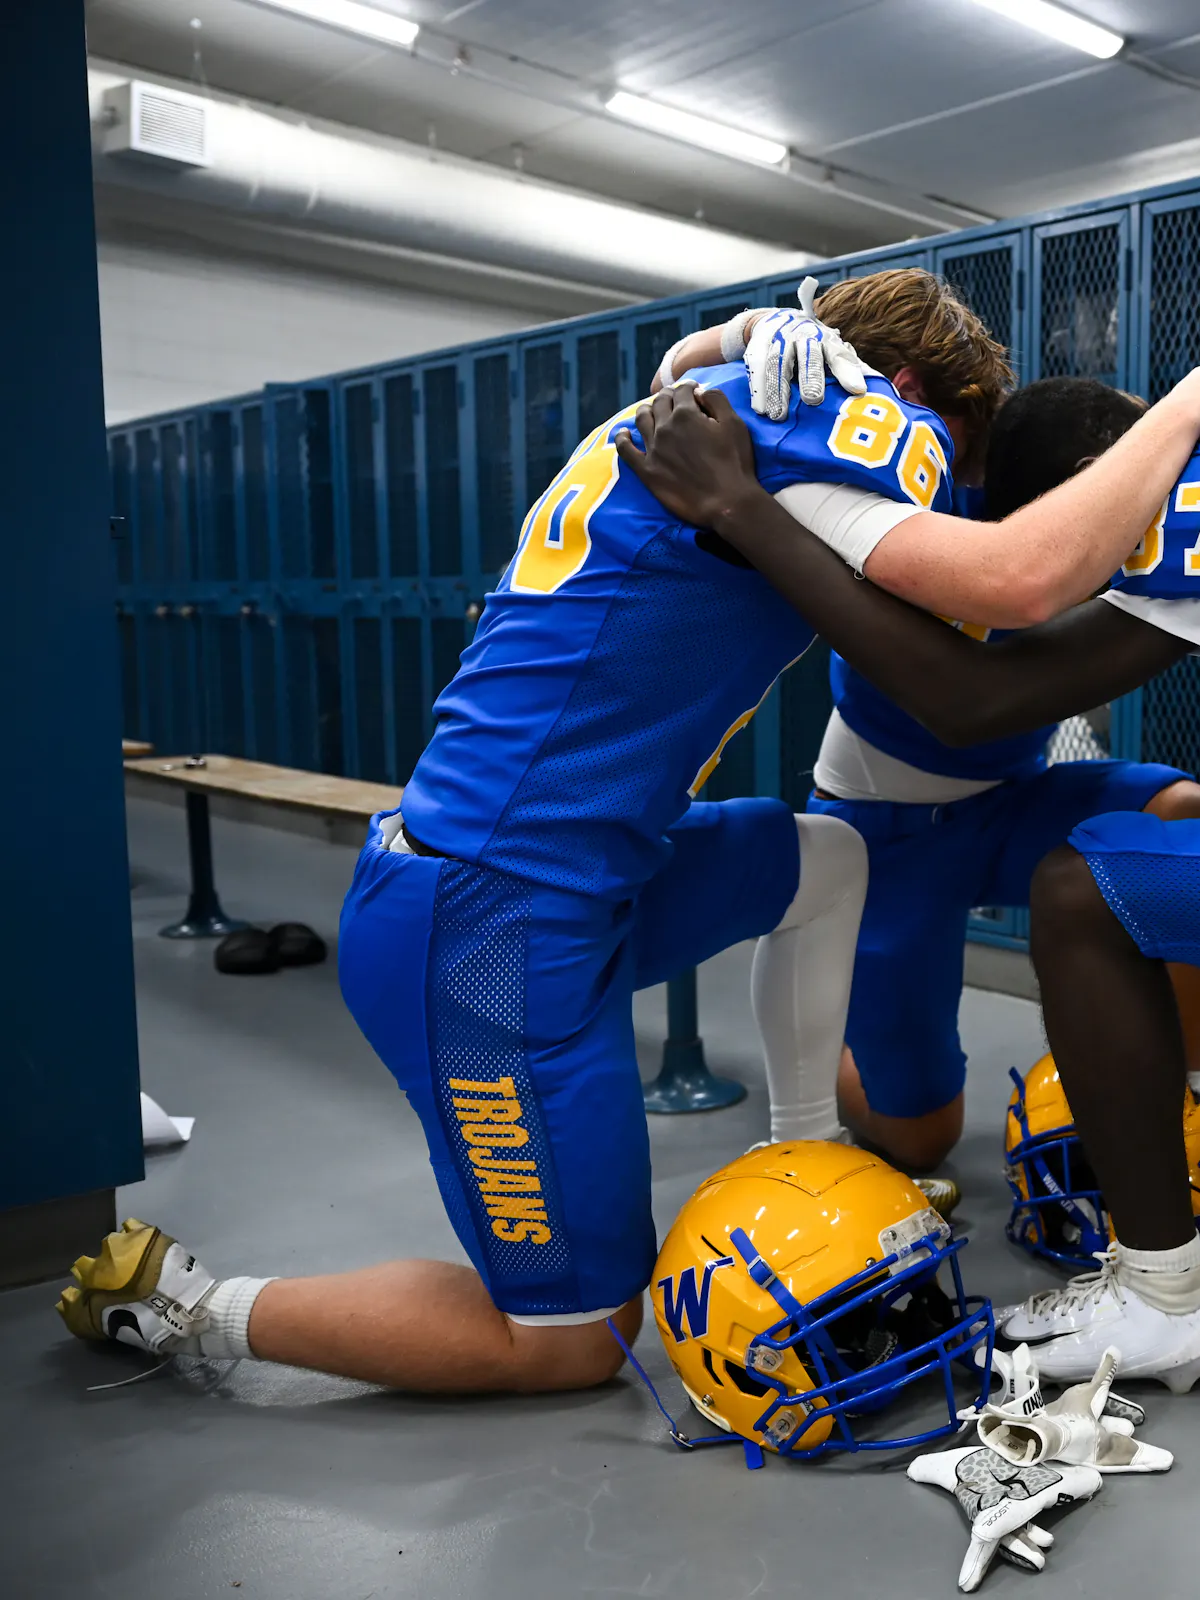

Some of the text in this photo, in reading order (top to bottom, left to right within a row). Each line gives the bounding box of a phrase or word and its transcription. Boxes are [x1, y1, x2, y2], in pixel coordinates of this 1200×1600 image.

[827, 392, 948, 511] 86
[449, 1076, 552, 1245] TROJANS
[657, 1256, 736, 1343] W
